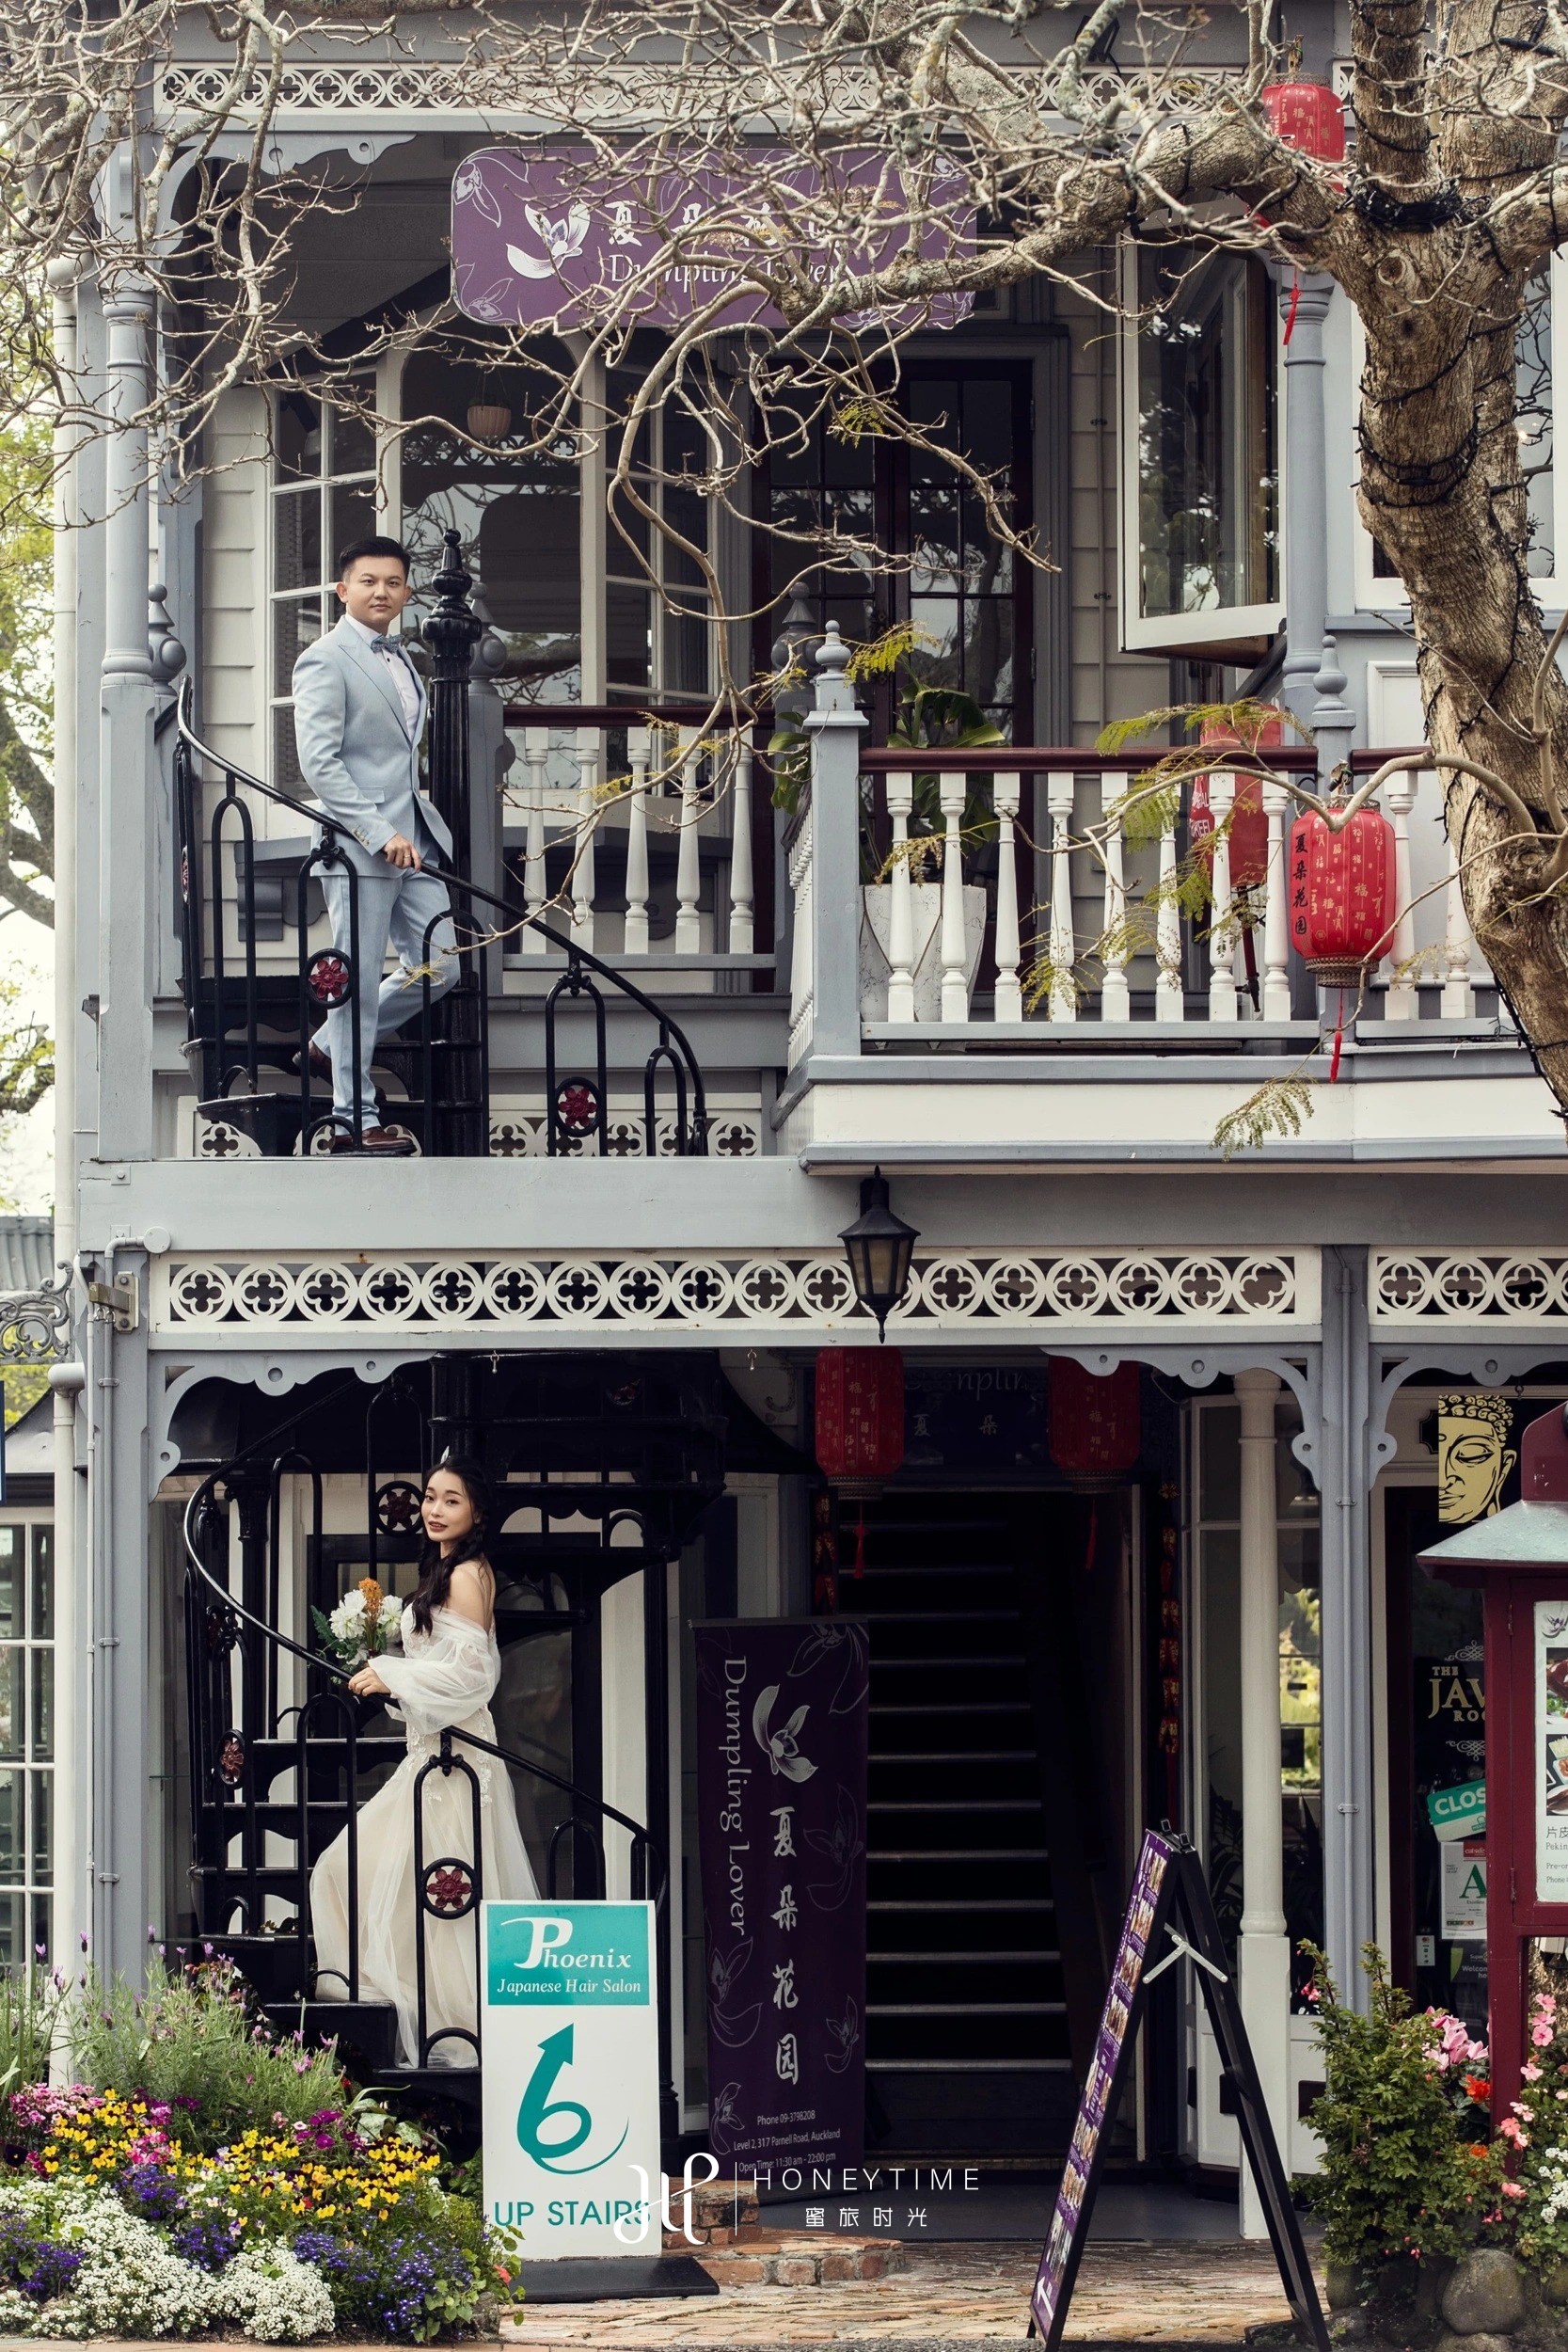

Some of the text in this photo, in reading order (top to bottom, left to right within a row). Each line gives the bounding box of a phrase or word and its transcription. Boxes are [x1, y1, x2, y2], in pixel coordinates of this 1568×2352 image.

[1292, 834, 1308, 935] 夏朵花园
[1432, 1666, 1459, 1676] THE
[719, 1656, 752, 1936] Dumpling Lover
[1459, 1864, 1487, 1899] A
[500, 1916, 632, 1969] Phoenix
[769, 1805, 800, 2086] 夏朵花园
[497, 1979, 641, 1995] Japanese Hair Salon
[757, 2115, 779, 2126] Phone
[734, 2137, 751, 2151] Level
[771, 2134, 792, 2146] Parnell
[793, 2132, 810, 2145] Road,
[811, 2127, 841, 2142] Auckland
[738, 2161, 755, 2174] Open
[755, 2159, 775, 2171] Time:
[775, 2155, 791, 2169] 11:30
[790, 2156, 802, 2167] am
[807, 2153, 825, 2166] 22:00
[826, 2153, 836, 2164] pm
[494, 2200, 651, 2227] UP STAIRS
